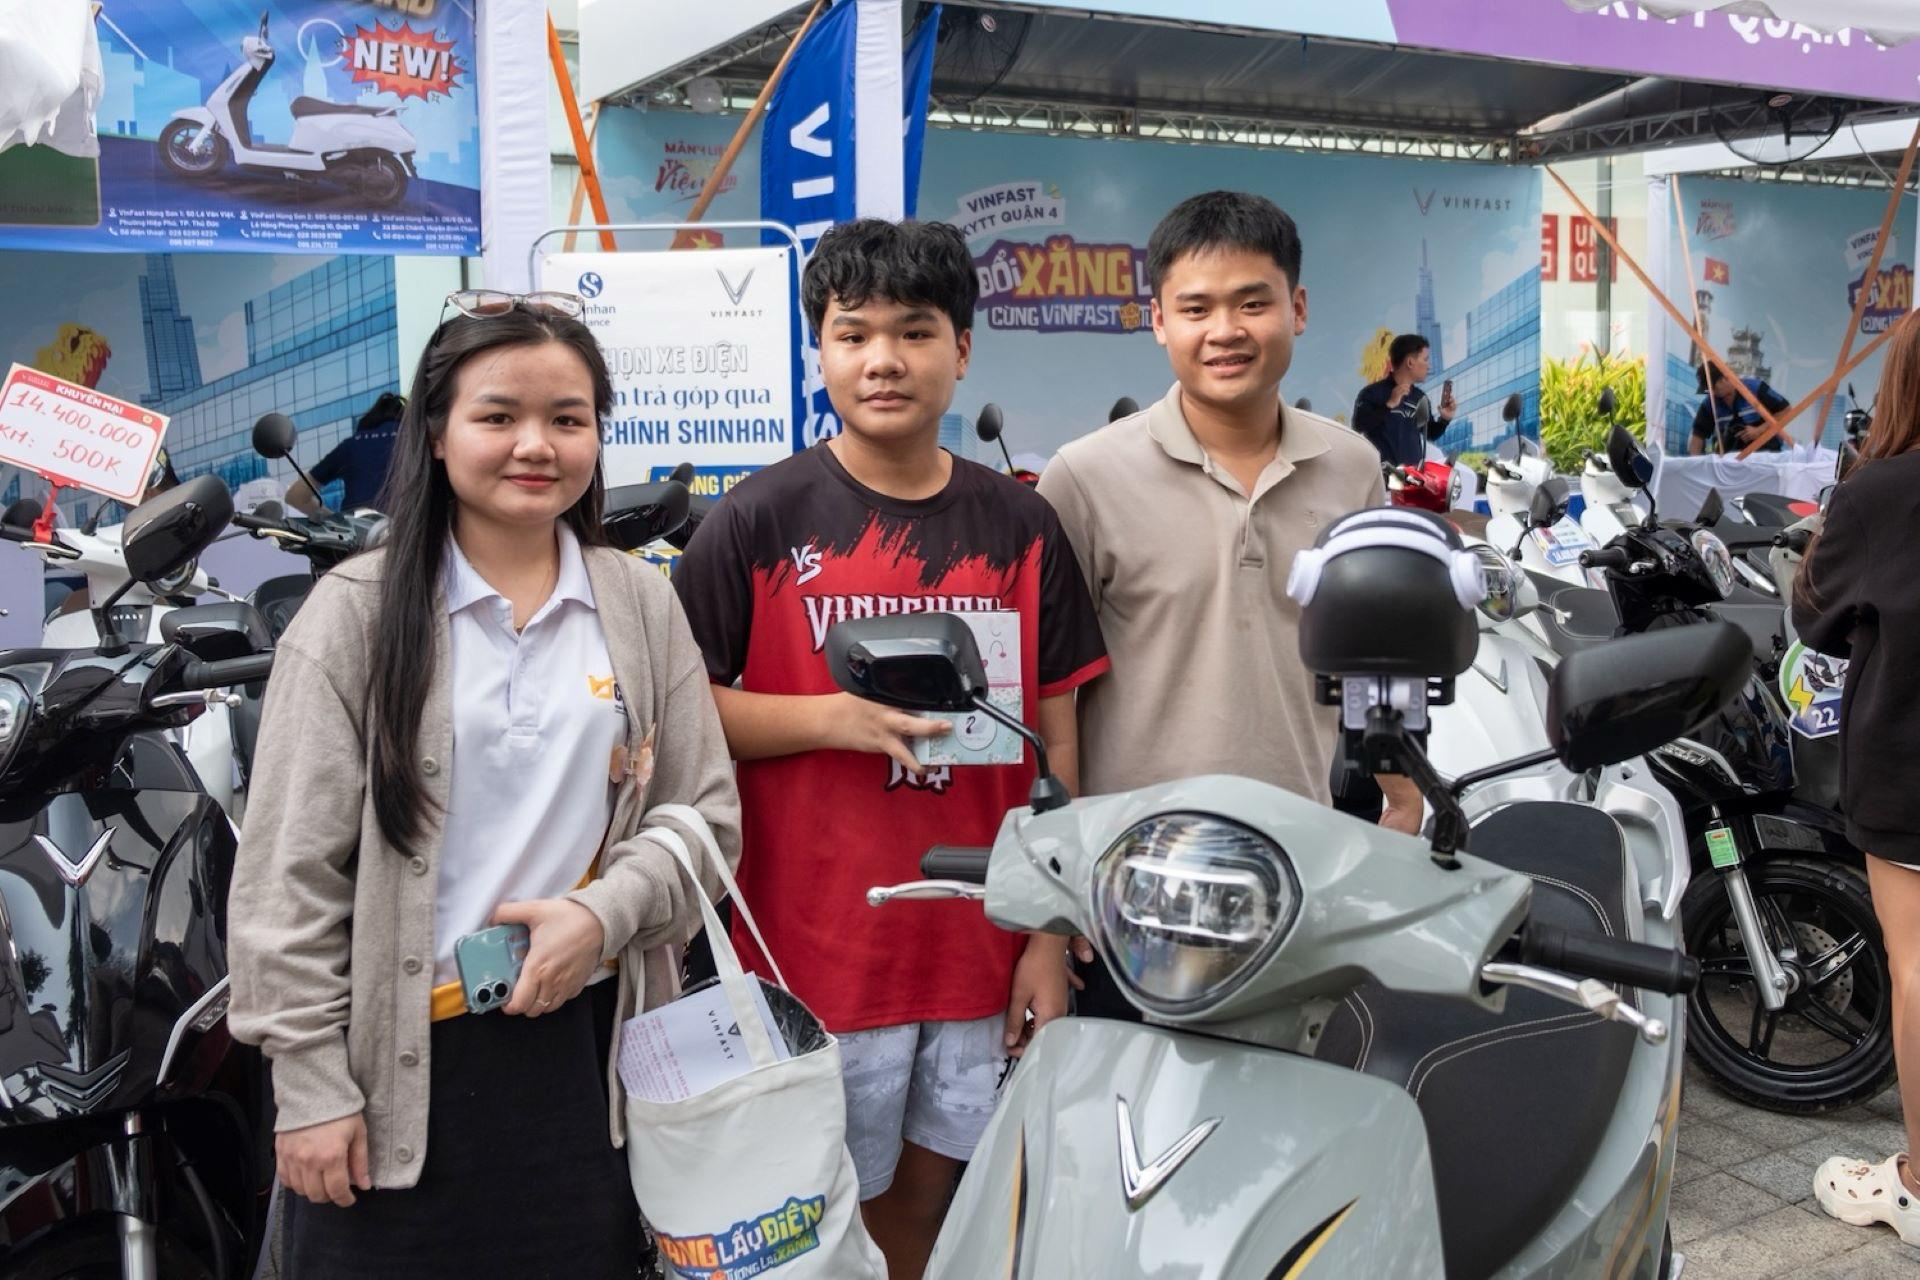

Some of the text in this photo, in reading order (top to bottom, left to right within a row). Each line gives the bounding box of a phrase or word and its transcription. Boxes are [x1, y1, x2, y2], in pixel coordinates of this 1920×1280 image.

[354, 38, 450, 81] NEW!
[967, 187, 1036, 213] VINFAST
[1443, 196, 1511, 211] VINFAST
[1001, 206, 1044, 224] QUẬN
[1048, 207, 1058, 219] 4
[1014, 241, 1134, 296] XĂNG
[710, 309, 764, 318] VINFAST
[991, 302, 1040, 327] CÙNG
[656, 345, 686, 375] XE
[691, 340, 748, 379] ĐIỆN
[55, 384, 102, 407] KHUYẾN
[633, 384, 667, 406] trả
[673, 385, 719, 411] góp
[724, 387, 772, 410] qua
[603, 415, 785, 445] CHÍNH SHINHAN
[791, 544, 824, 587] VS
[708, 1009, 735, 1060] VINFAST
